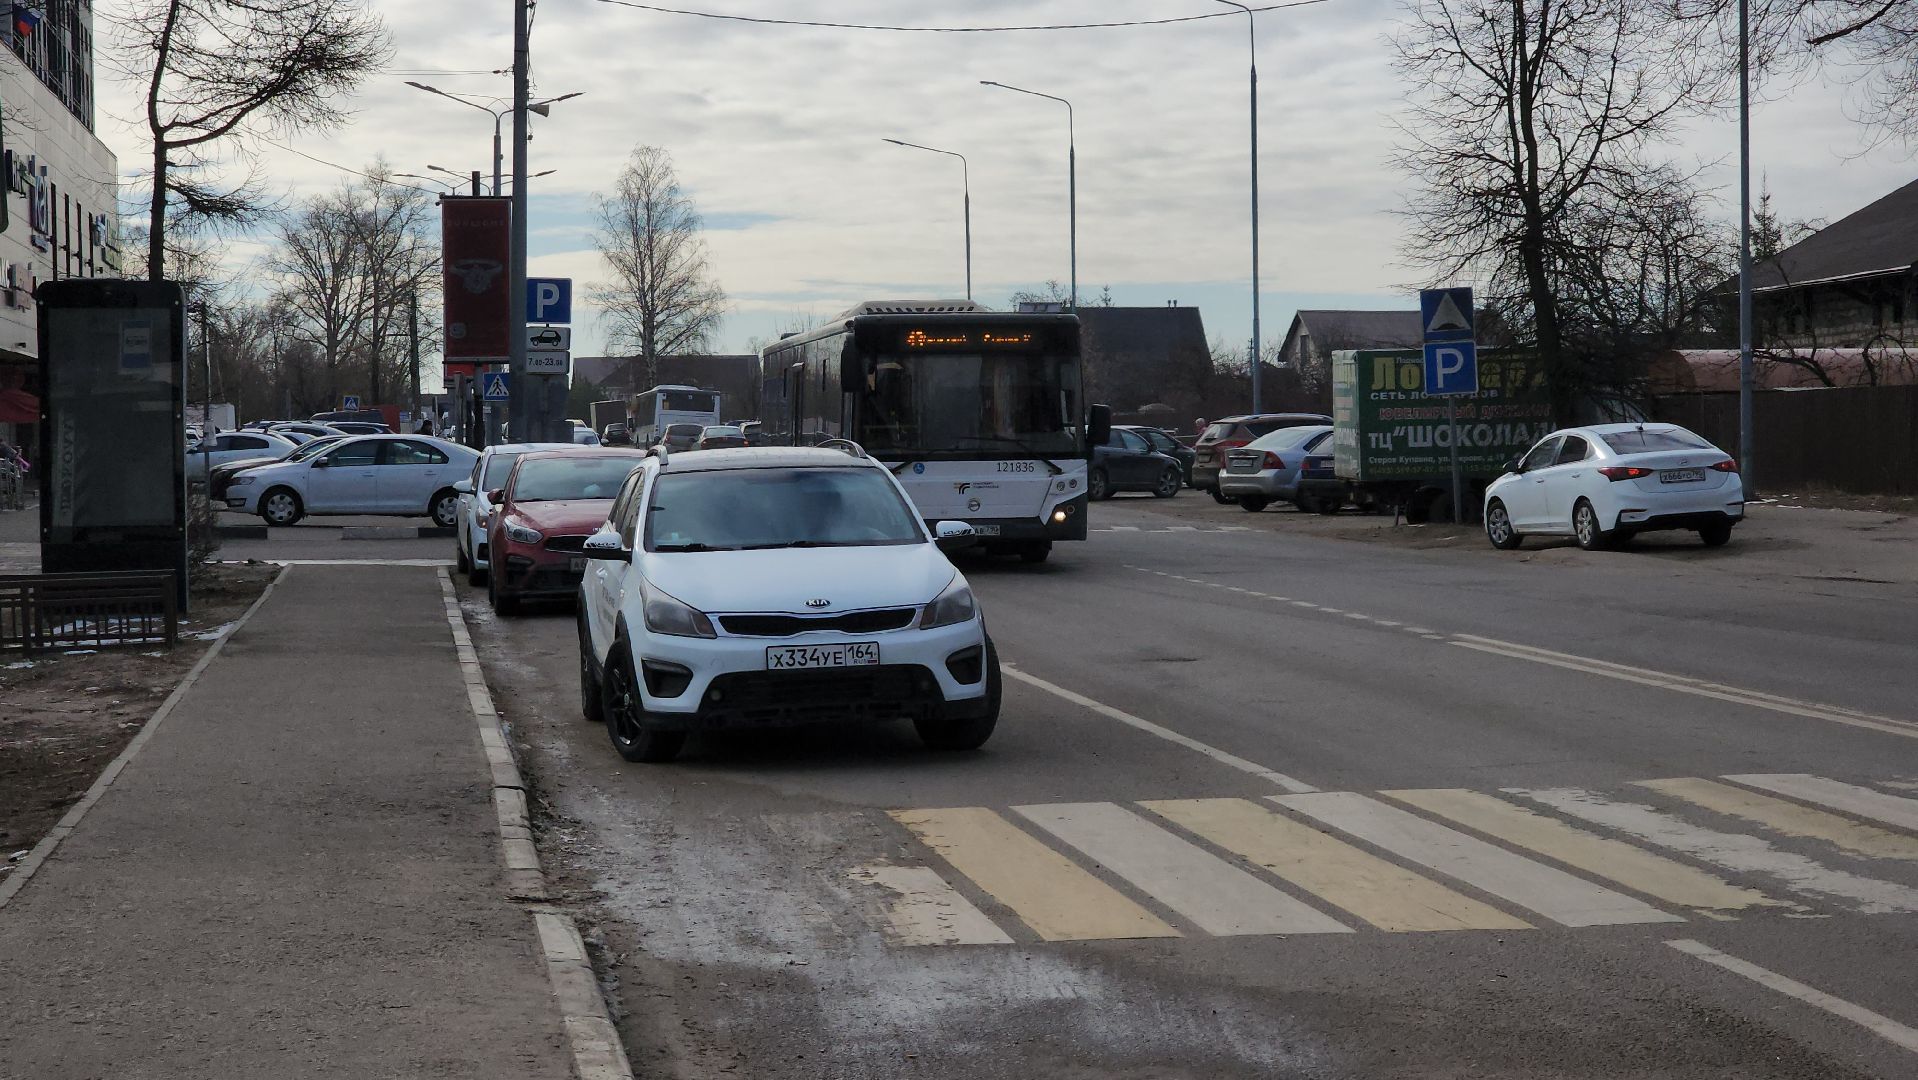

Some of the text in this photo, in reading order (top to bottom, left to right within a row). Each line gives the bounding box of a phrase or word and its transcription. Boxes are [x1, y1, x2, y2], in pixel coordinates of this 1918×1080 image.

[537, 282, 560, 318] P
[1436, 348, 1464, 389] P
[1370, 391, 1406, 400] СЕТЬ
[1368, 432, 1393, 452] ТЦ
[996, 461, 1035, 474] 121836
[774, 648, 843, 668] Х334УЕ
[847, 645, 874, 659] 164
